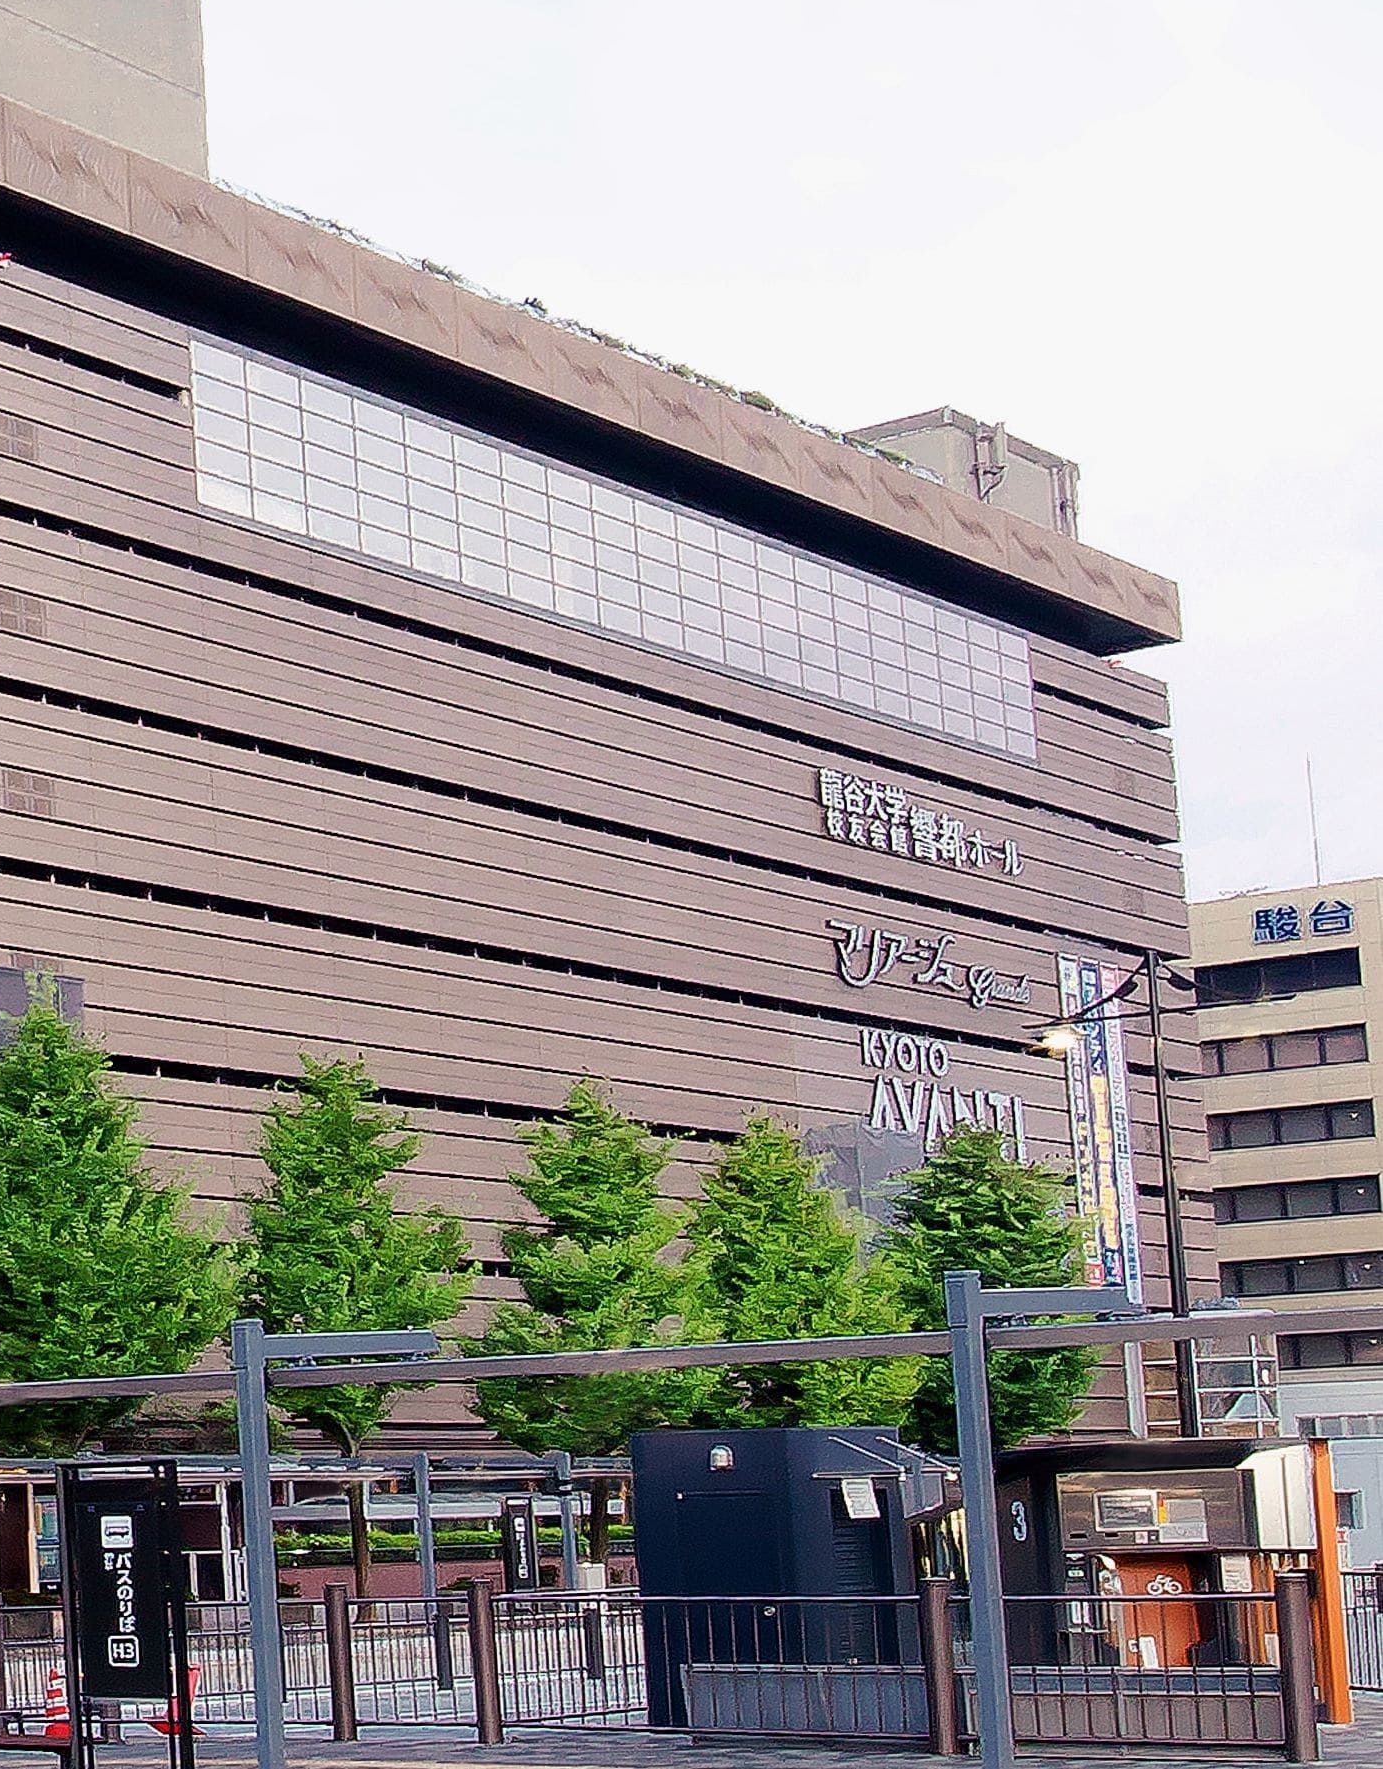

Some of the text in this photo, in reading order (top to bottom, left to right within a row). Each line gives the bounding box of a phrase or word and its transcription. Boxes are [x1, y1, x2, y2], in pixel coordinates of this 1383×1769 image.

[1254, 900, 1353, 942] 駿台
[861, 1029, 950, 1077] KYOTO
[871, 1074, 1027, 1164] AVANTI
[115, 1552, 137, 1633] バスのりば
[112, 1642, 136, 1659] H3
